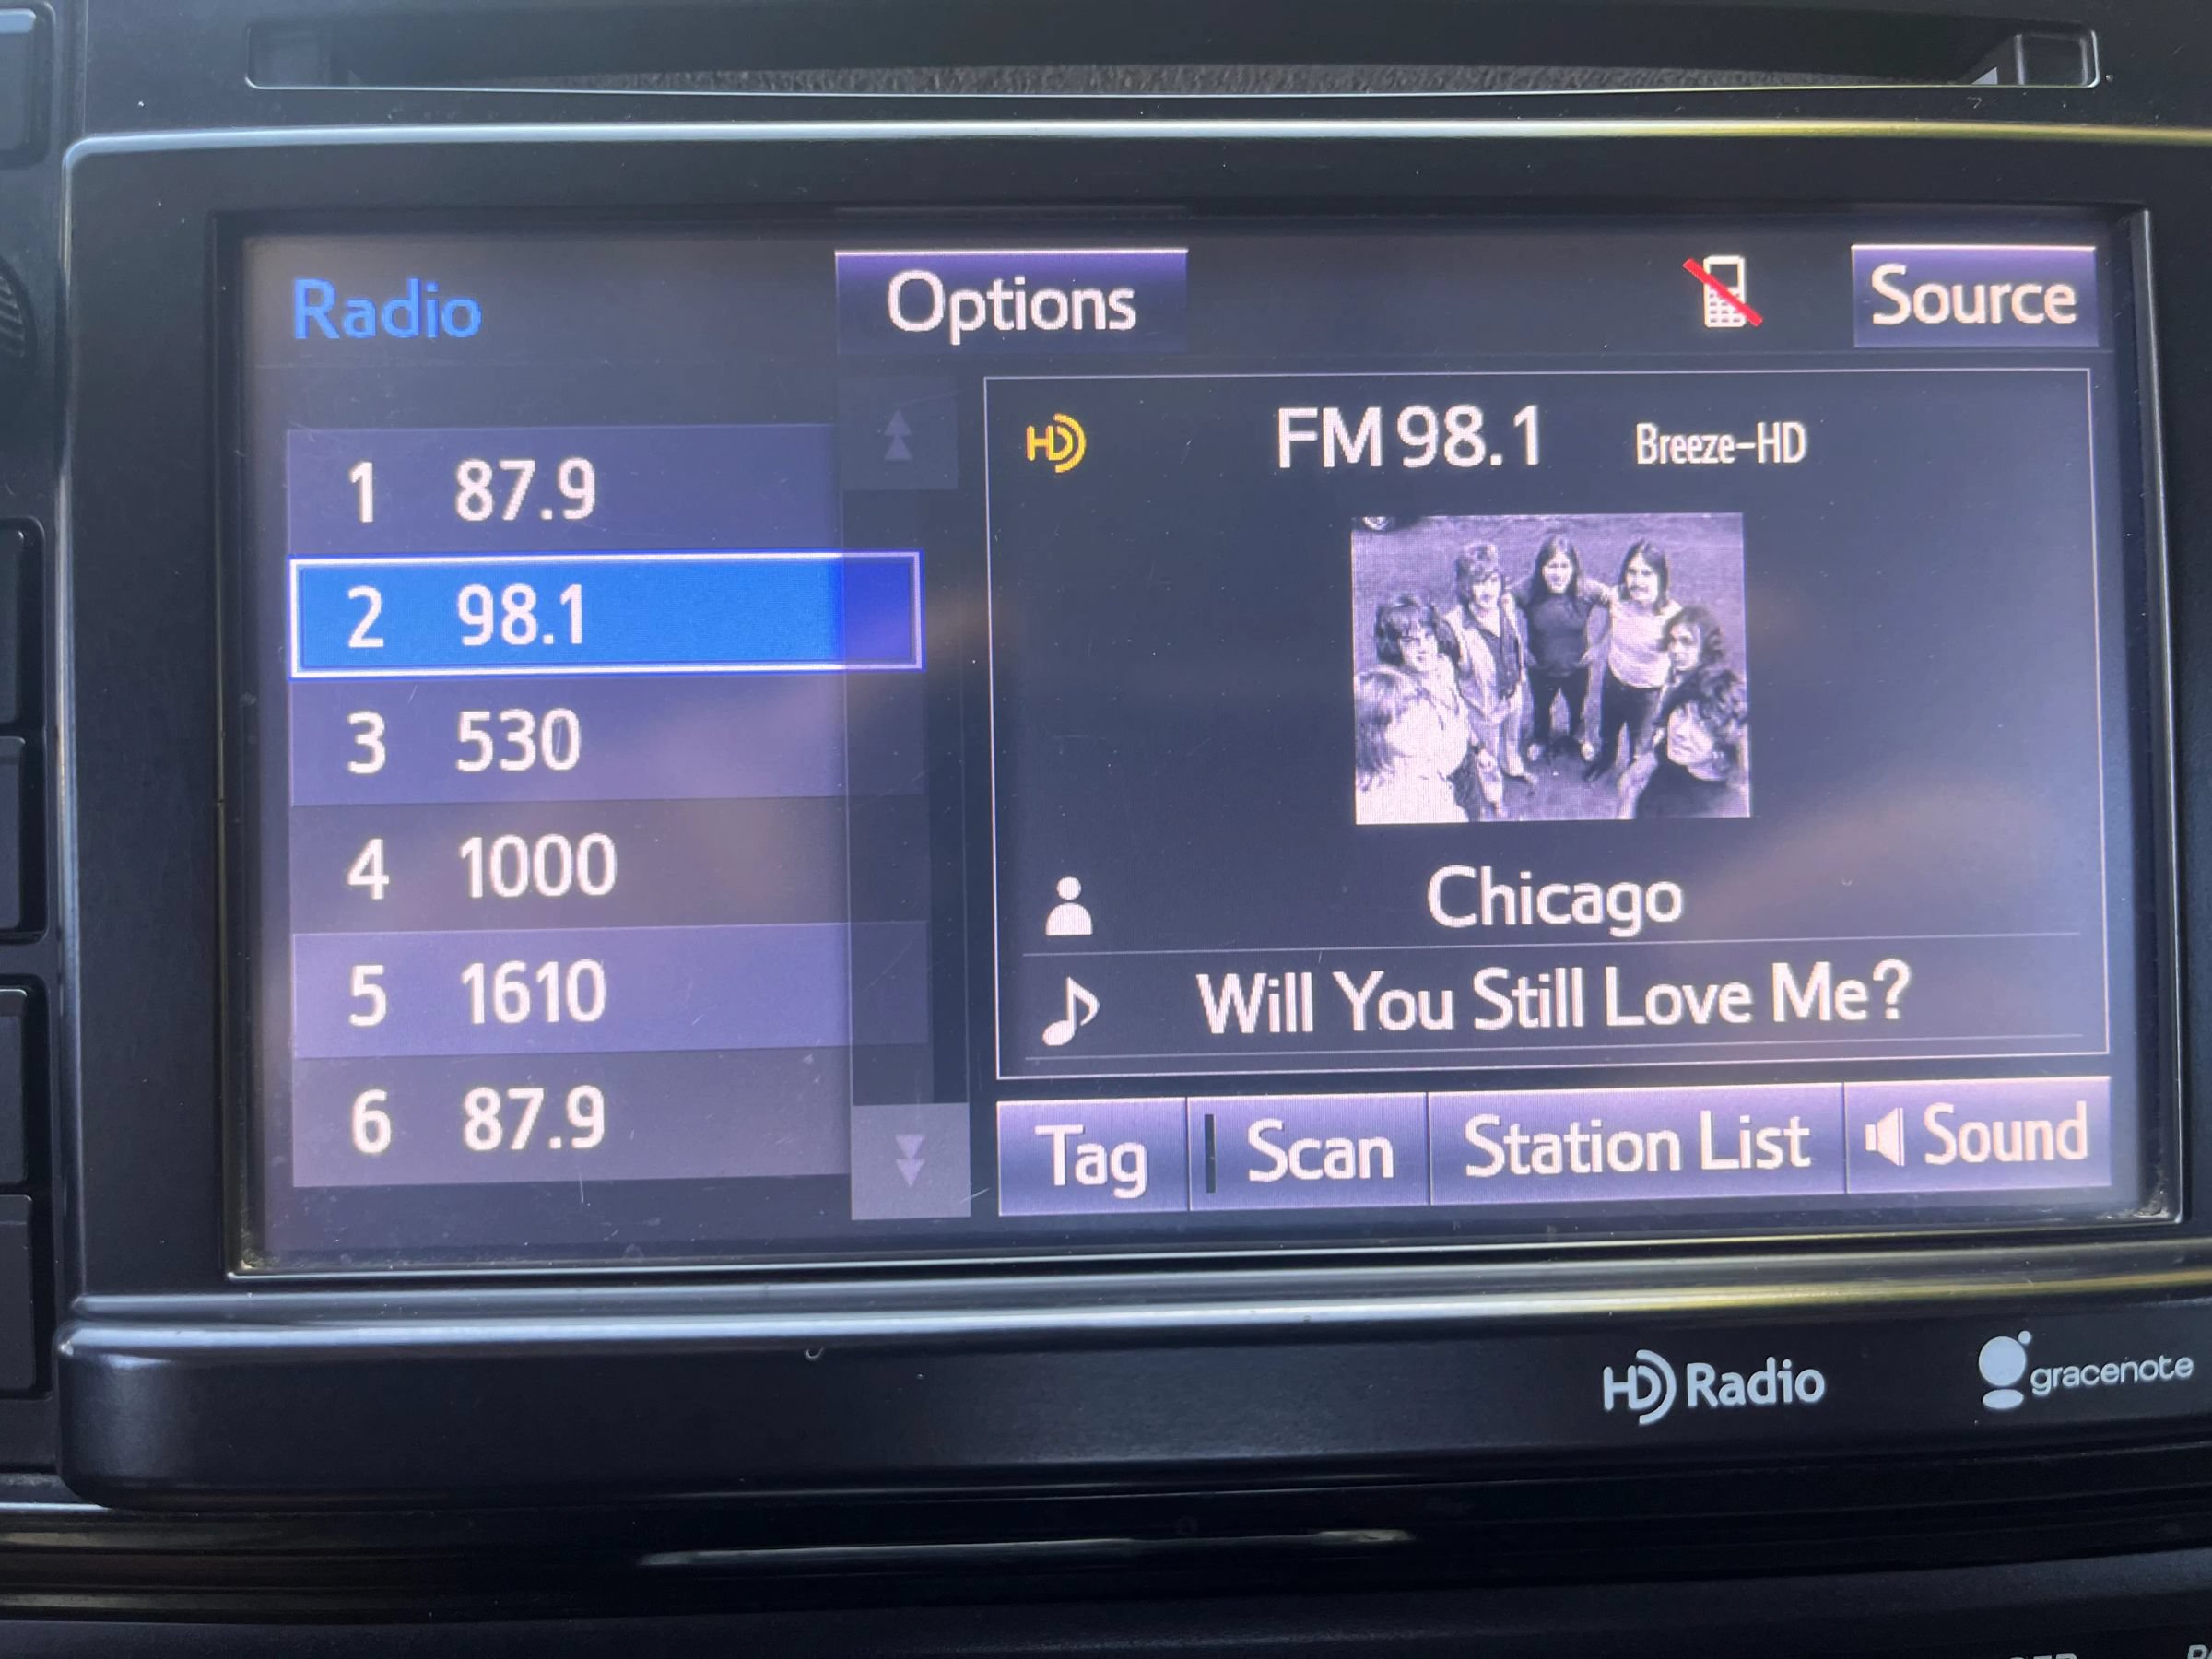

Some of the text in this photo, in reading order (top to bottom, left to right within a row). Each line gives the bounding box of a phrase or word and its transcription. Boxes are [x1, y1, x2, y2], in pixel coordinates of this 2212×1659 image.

[293, 278, 482, 339] Radio
[888, 270, 1136, 346] Options
[1871, 264, 2078, 326] Source
[1277, 405, 1541, 469] FM 98.1
[1635, 420, 1808, 465] Breeze-HD
[348, 457, 596, 523] 1 87.9
[347, 583, 582, 648] 2 98.1
[347, 708, 581, 774] 3 530
[346, 832, 618, 900] 4 1000
[1427, 865, 1686, 938] Chicago
[347, 959, 606, 1027] 5 1610
[1195, 959, 1912, 1034] Will You Still Love Me?
[350, 1085, 606, 1153] 6 87.9
[1246, 1118, 1395, 1183] Scan
[1464, 1111, 1812, 1178] Station List
[1924, 1100, 2089, 1165] Sound
[1034, 1124, 1148, 1199] Tag
[1687, 1357, 1826, 1408] Radio
[2030, 1355, 2194, 1397] gracenote
